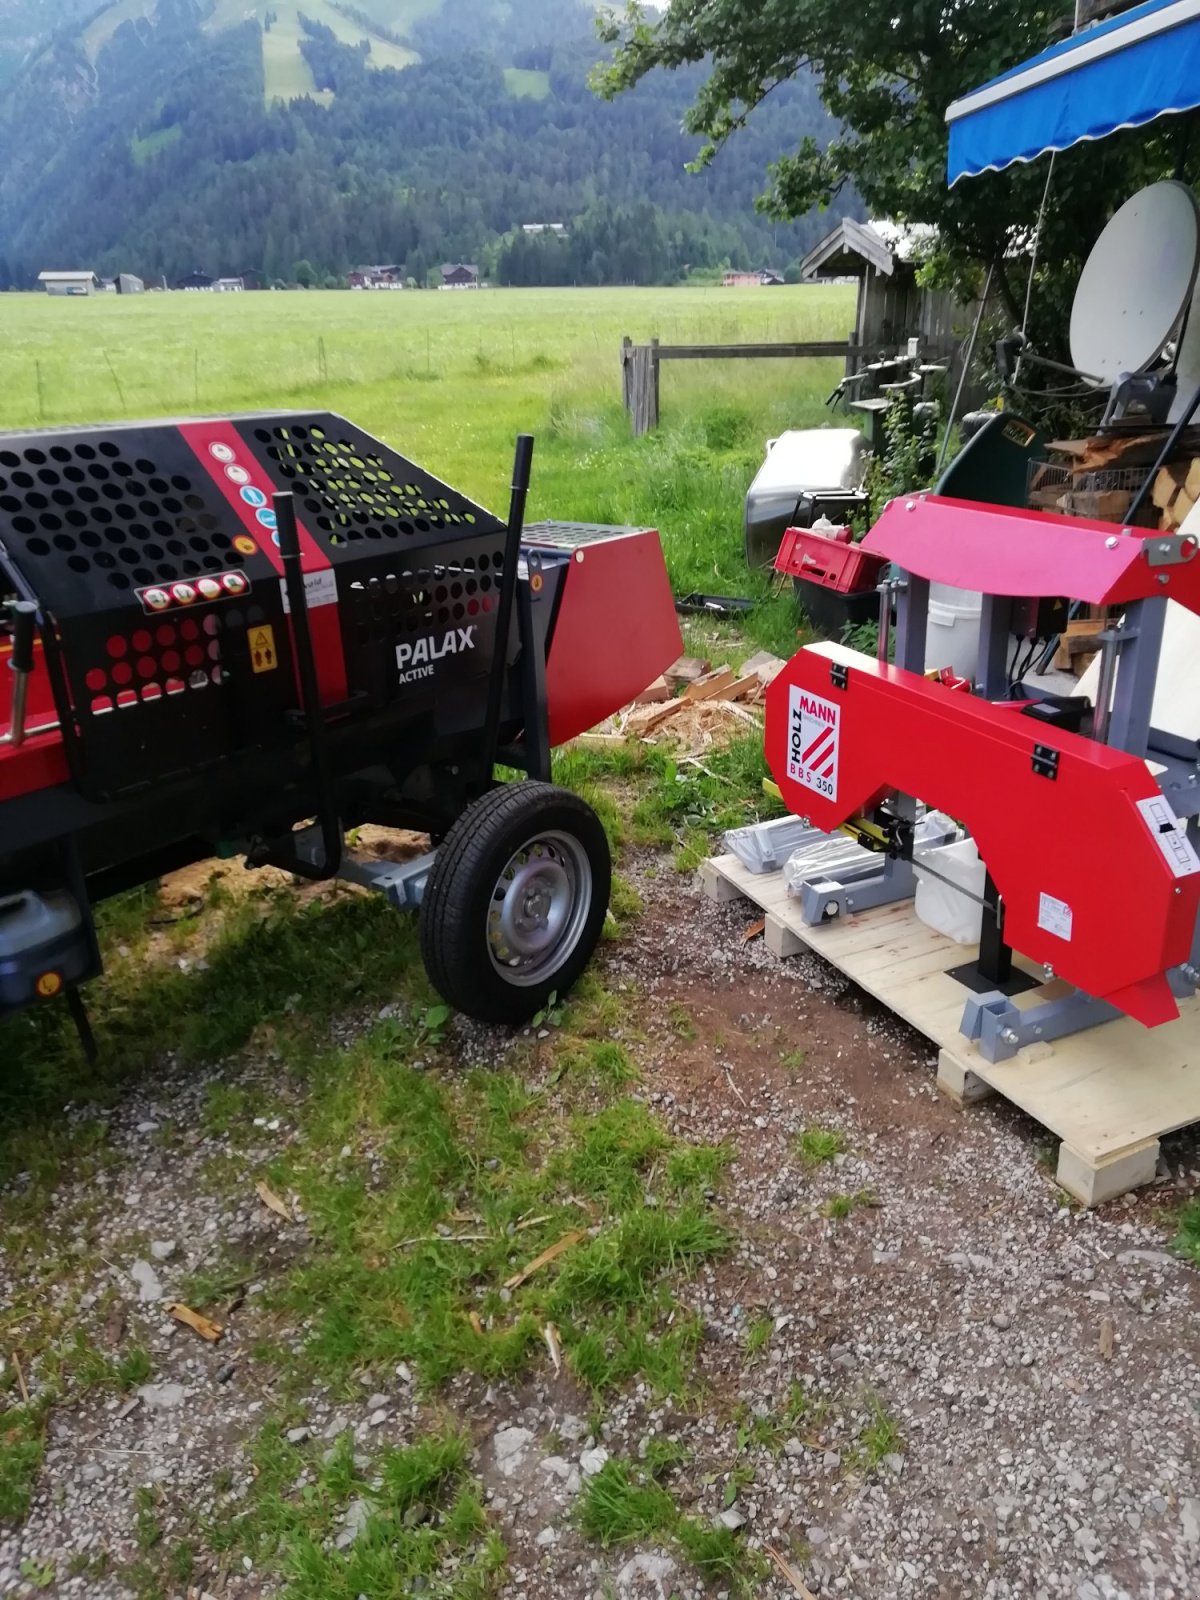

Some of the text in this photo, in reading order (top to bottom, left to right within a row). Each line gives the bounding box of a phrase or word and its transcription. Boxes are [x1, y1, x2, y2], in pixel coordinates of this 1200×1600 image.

[395, 625, 475, 669] PALAX
[399, 664, 435, 684] ACTIVE
[799, 695, 836, 726] MANN
[791, 708, 802, 764] HOLZ
[816, 777, 834, 795] 350
